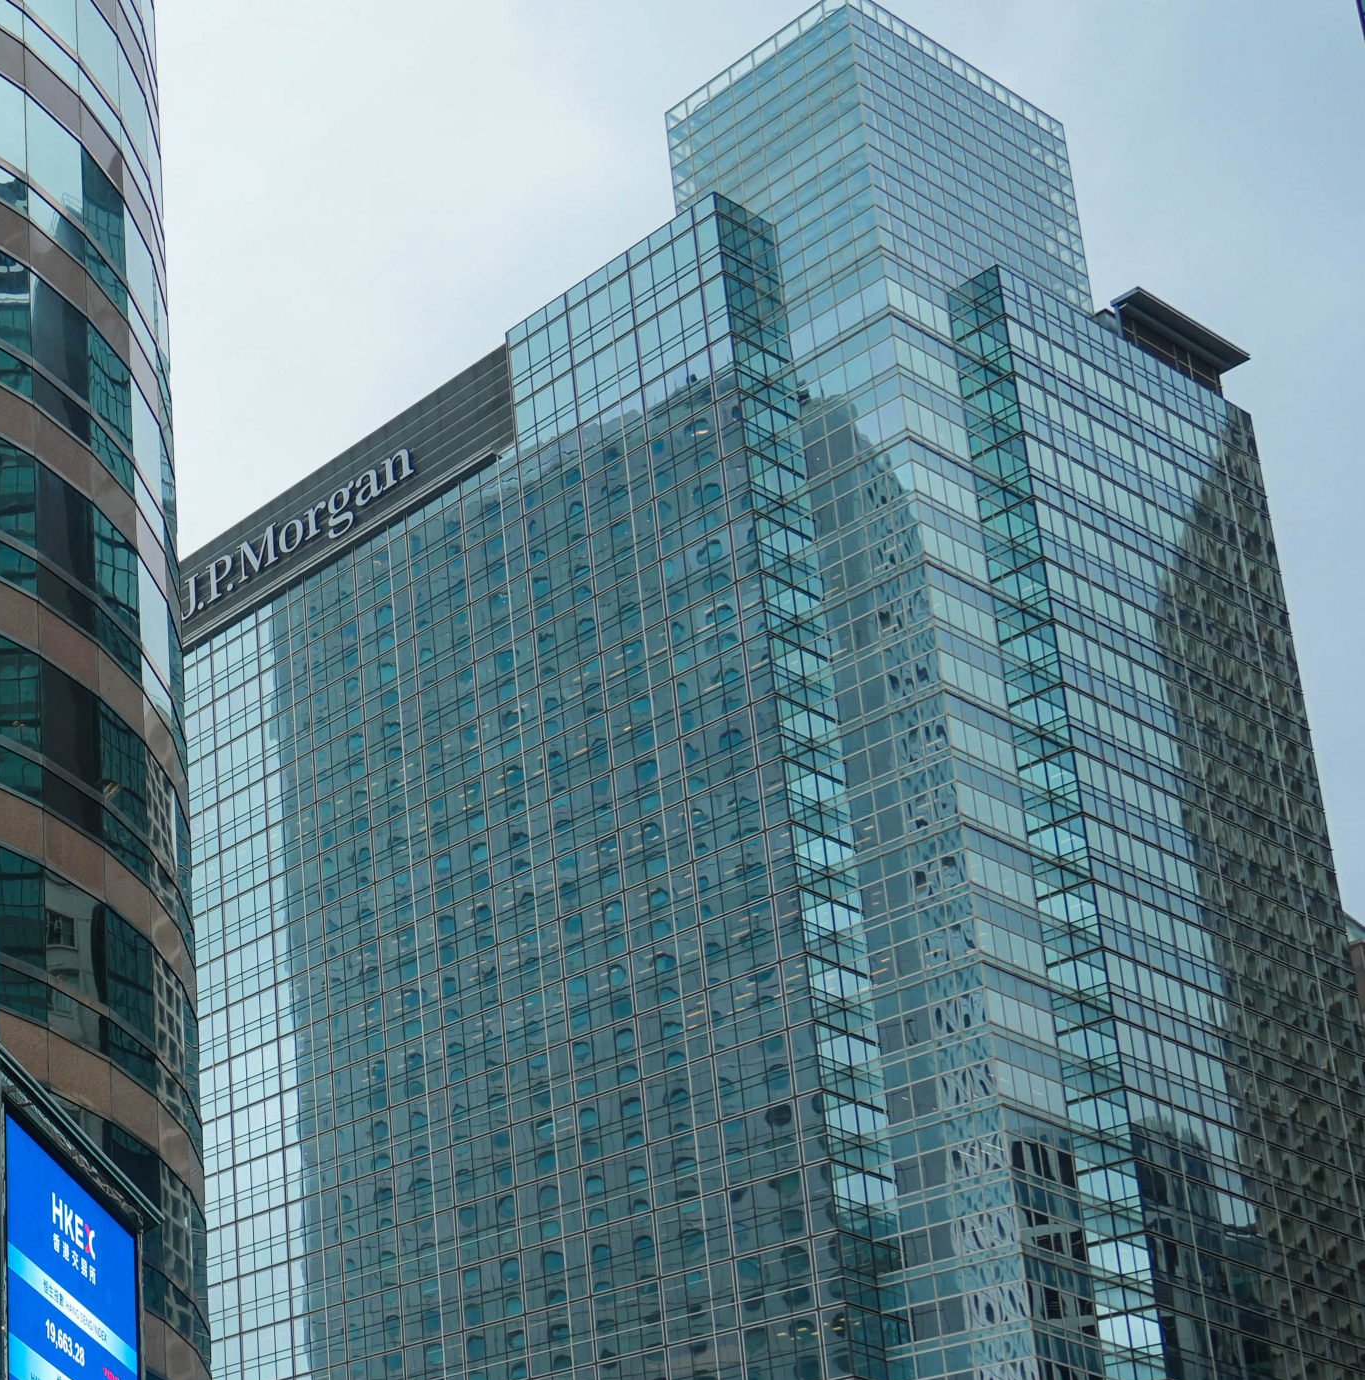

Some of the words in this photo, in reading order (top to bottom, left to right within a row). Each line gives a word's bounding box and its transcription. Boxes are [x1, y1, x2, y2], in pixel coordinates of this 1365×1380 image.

[51, 1191, 96, 1261] HKEX
[52, 1233, 97, 1286] 香港交易所
